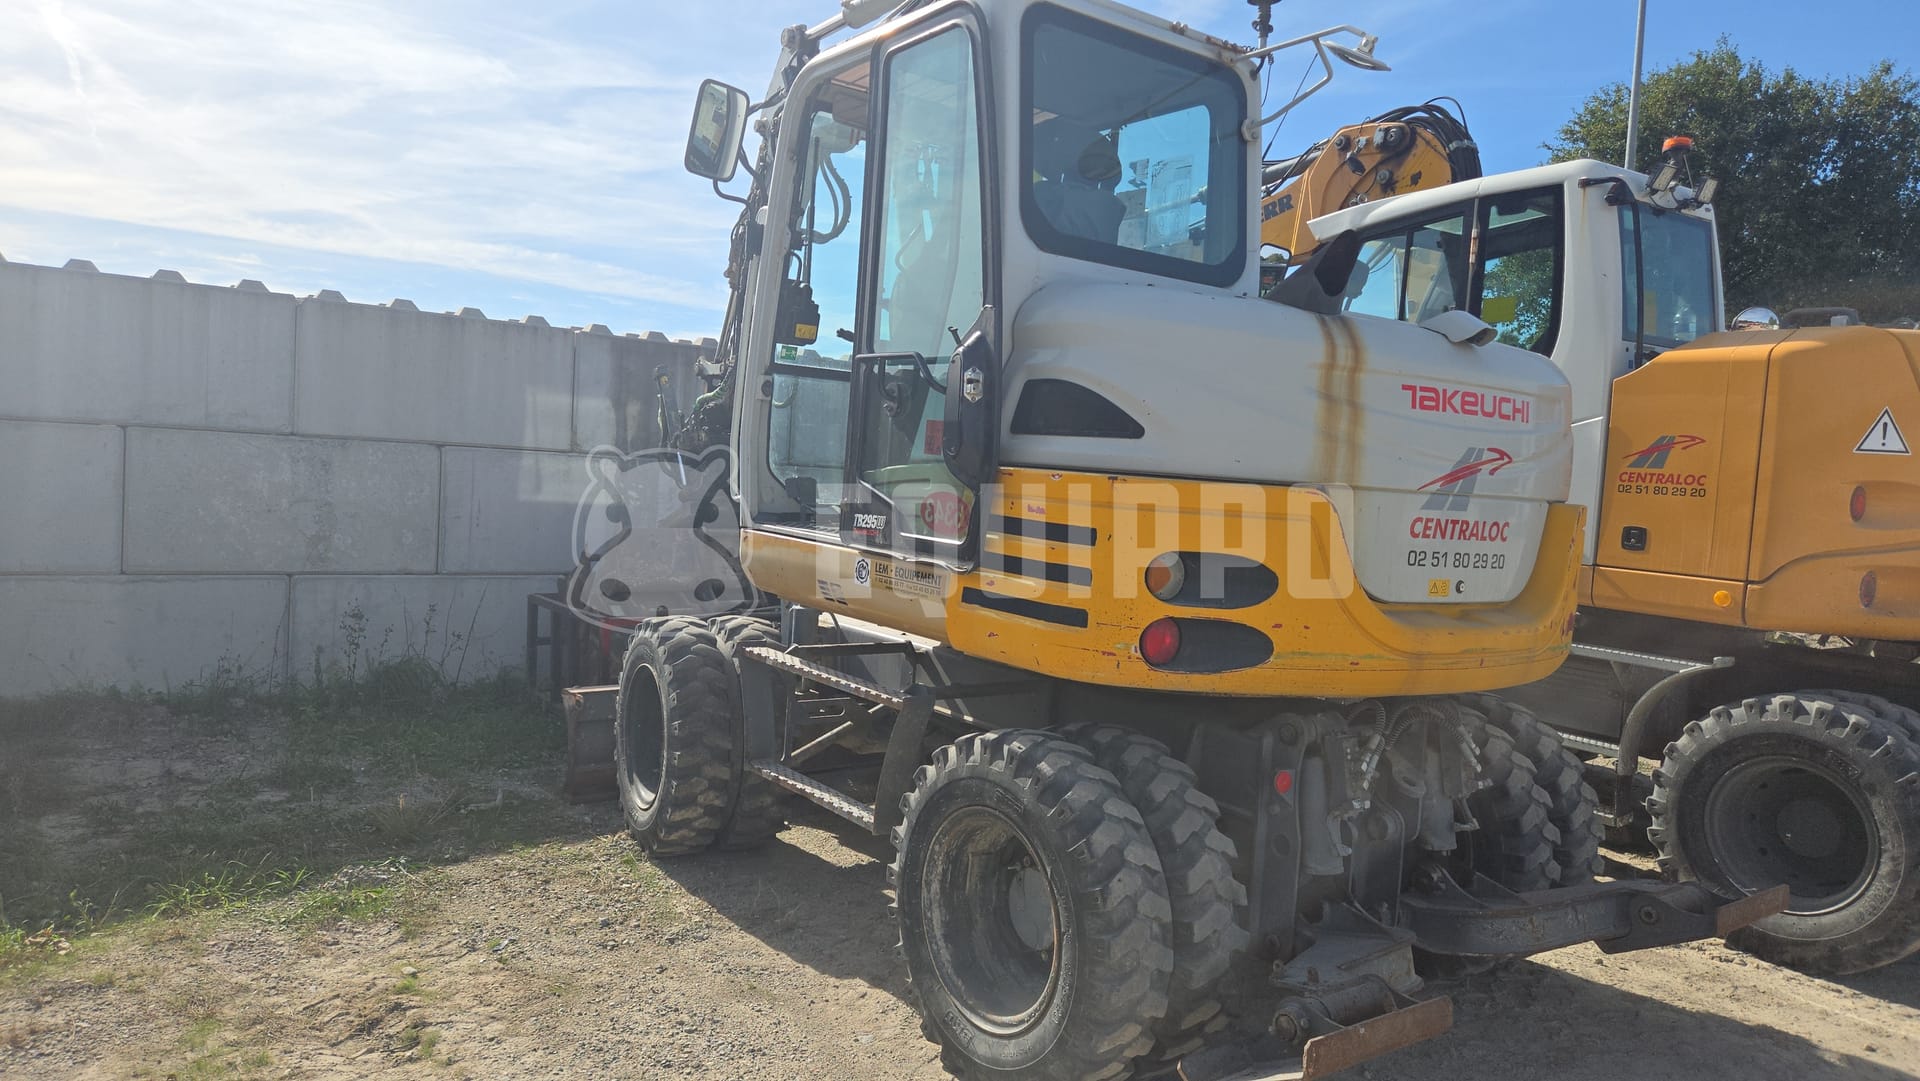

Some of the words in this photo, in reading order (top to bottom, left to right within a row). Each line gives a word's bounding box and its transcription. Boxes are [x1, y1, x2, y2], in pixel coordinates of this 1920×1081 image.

[1261, 194, 1294, 223] RR
[1401, 384, 1530, 424] TAKEUCHI
[1617, 484, 1632, 494] 02
[1635, 485, 1649, 495] 51
[1653, 486, 1668, 496] 80
[1671, 486, 1687, 497] 29
[1690, 487, 1706, 498] 20
[1618, 471, 1707, 486] CENTRALOC
[1409, 516, 1510, 543] CENTRALOC
[1407, 550, 1427, 567] 02
[1431, 551, 1448, 568] 51
[1453, 552, 1471, 568] 80
[1473, 553, 1489, 569] 29
[1491, 554, 1505, 569] 20
[875, 561, 889, 576] LEM
[894, 566, 942, 587] EQUIPEMENT
